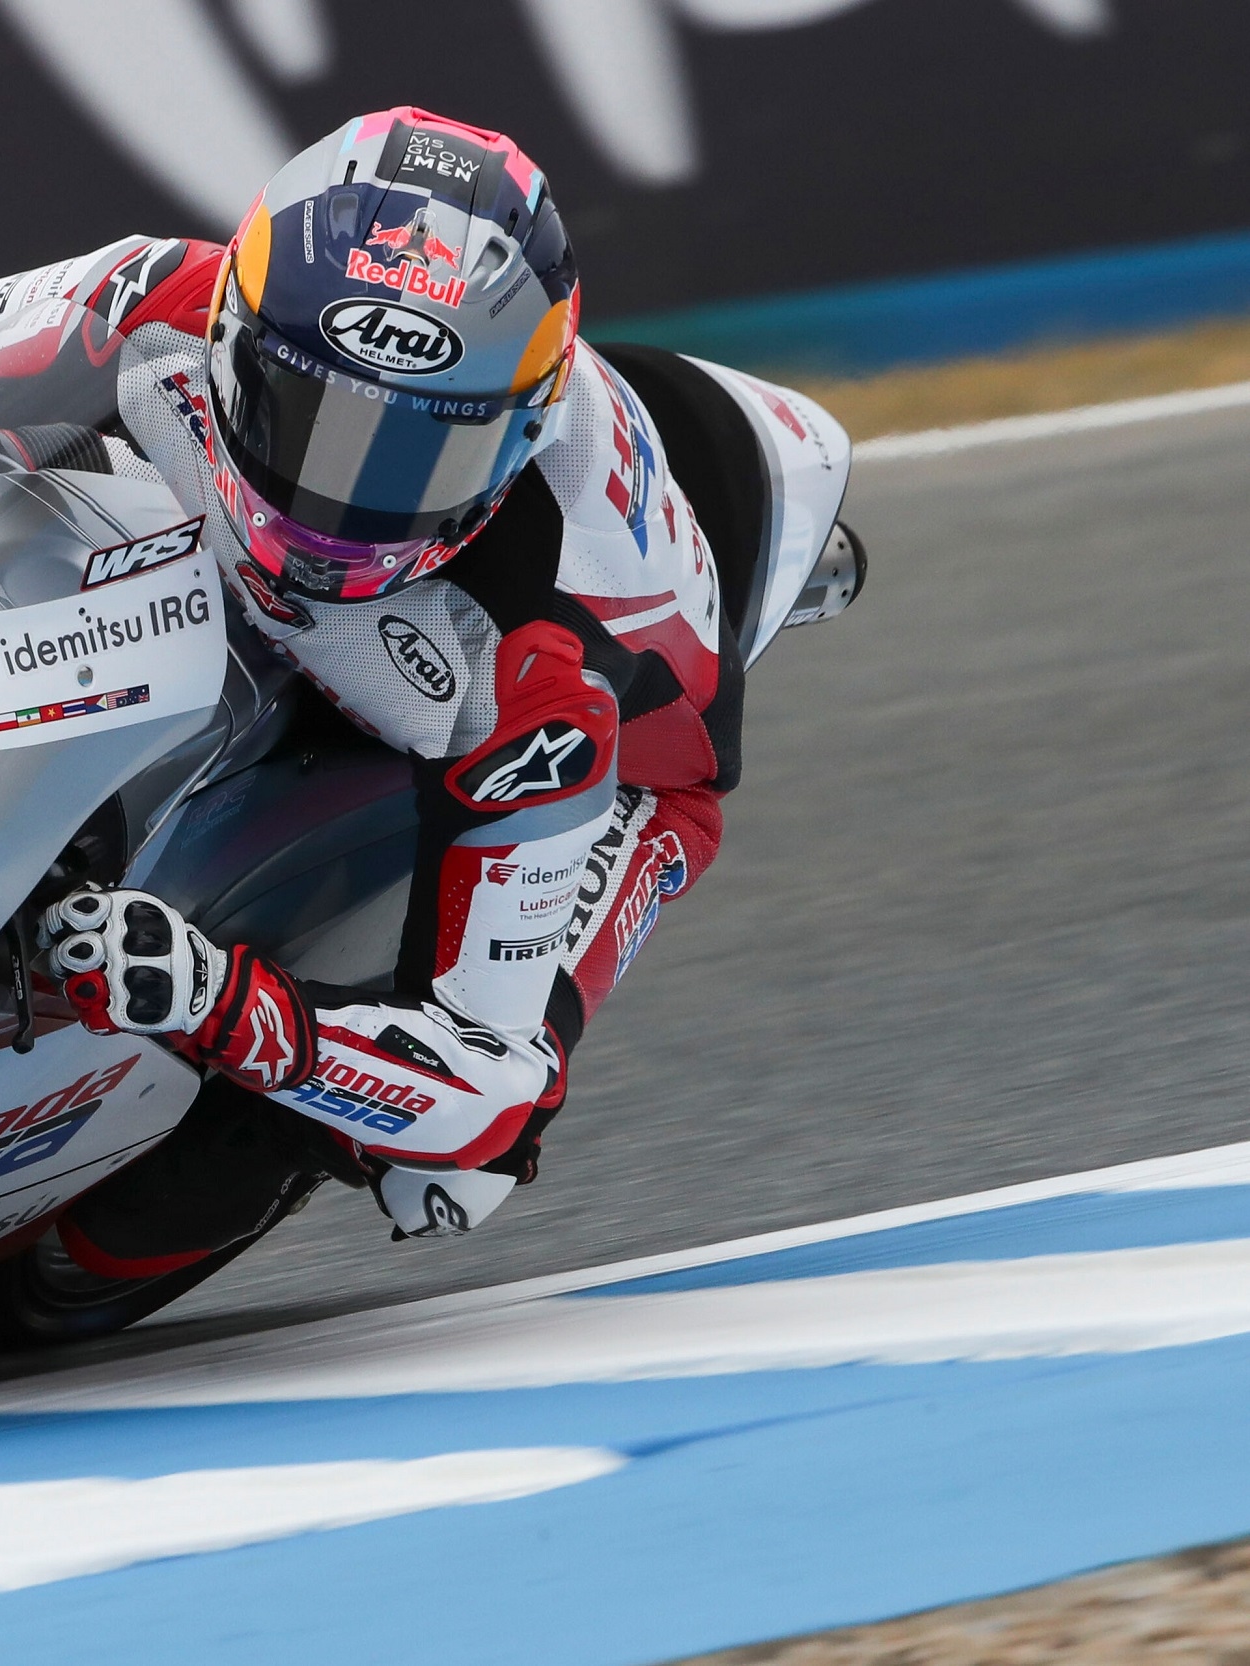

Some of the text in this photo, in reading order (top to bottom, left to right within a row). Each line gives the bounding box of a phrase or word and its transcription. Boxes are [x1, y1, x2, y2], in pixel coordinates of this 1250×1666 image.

[407, 144, 480, 172] GLOW
[410, 135, 444, 149] MS
[346, 248, 467, 309] Red Bull
[327, 307, 449, 361] Arai
[359, 347, 414, 367] HELMET
[277, 345, 487, 417] GIVES YOU WINGS
[86, 520, 201, 586] WRS
[0, 588, 211, 676] idemitsu IRG
[381, 631, 452, 691] Arai
